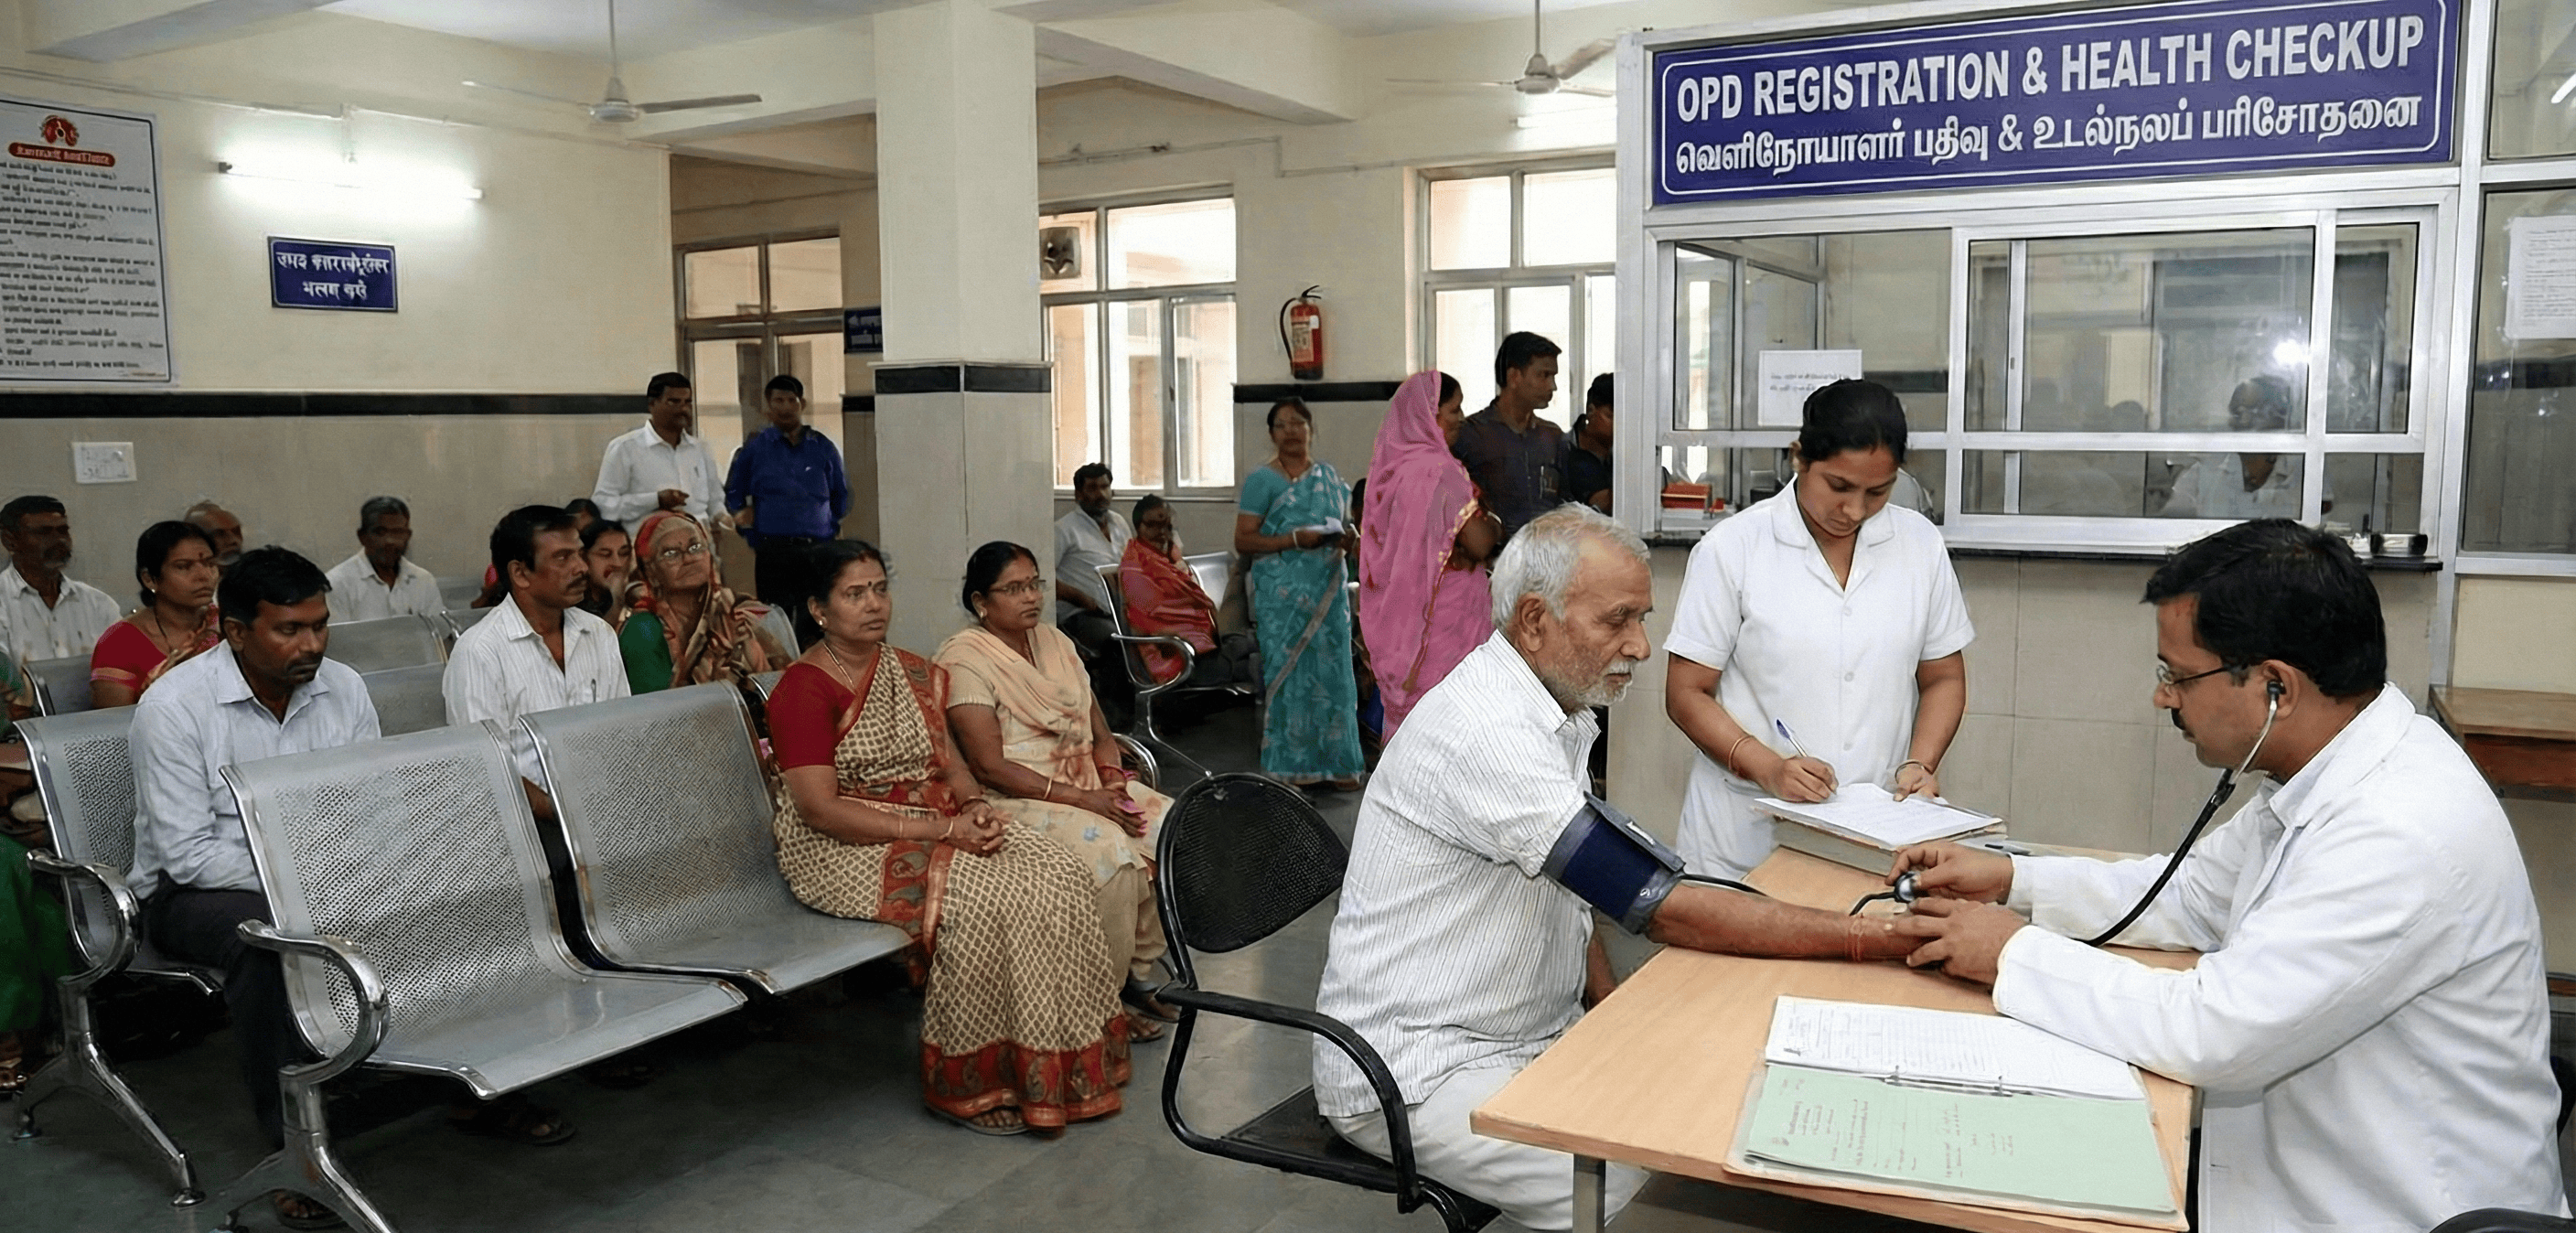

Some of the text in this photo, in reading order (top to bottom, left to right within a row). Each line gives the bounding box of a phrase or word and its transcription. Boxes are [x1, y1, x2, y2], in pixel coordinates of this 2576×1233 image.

[1677, 16, 2424, 123] OPD REGISTRATION & HEALTH CHECKUP
[1676, 94, 2422, 177] வெளிநோயாளர் பதிவு & உடல்நலப் பரிசோதனை
